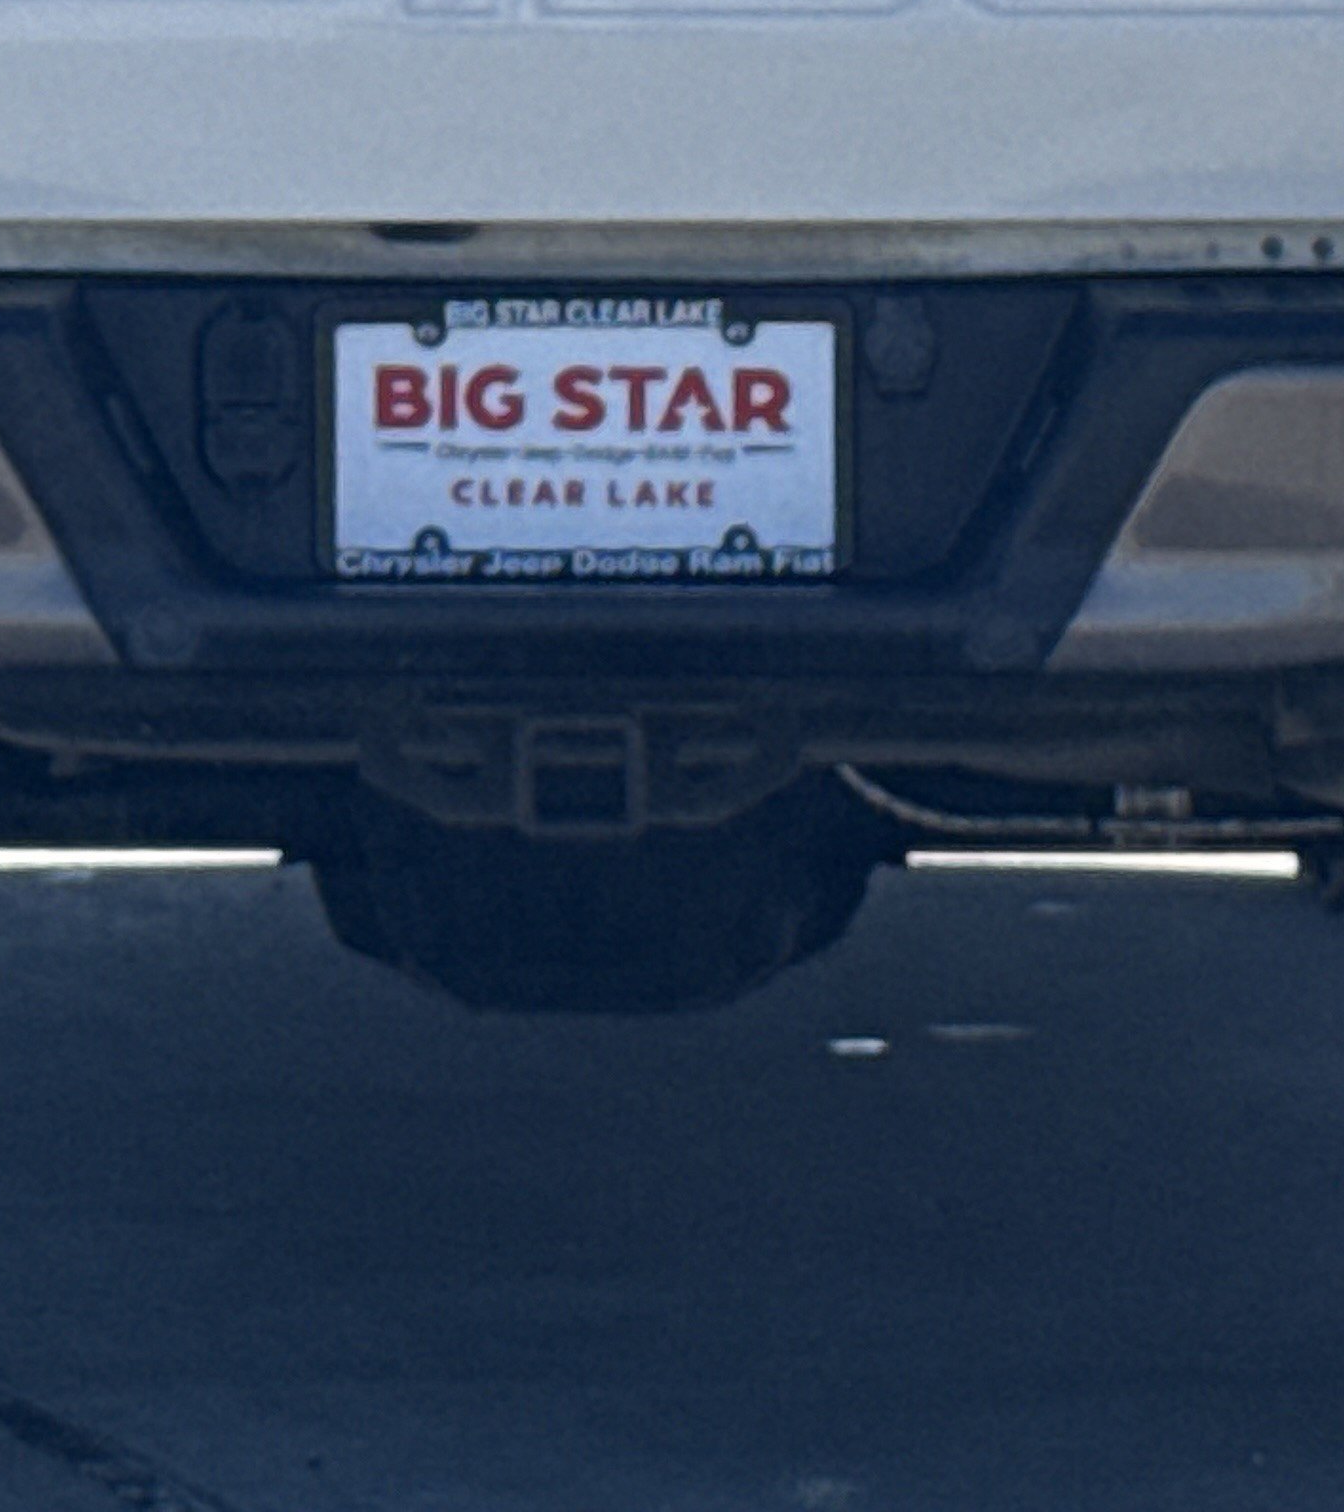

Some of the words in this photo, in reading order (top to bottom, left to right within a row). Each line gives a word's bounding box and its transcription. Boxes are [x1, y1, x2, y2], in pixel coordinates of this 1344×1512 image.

[445, 299, 488, 327] BIG
[494, 299, 560, 326] STAR
[565, 299, 651, 325] CLEAR
[656, 298, 723, 325] LAKE
[374, 364, 526, 431] BIG
[551, 365, 792, 433] STAR
[451, 480, 586, 507] CLEAR
[607, 480, 716, 507] LAKE
